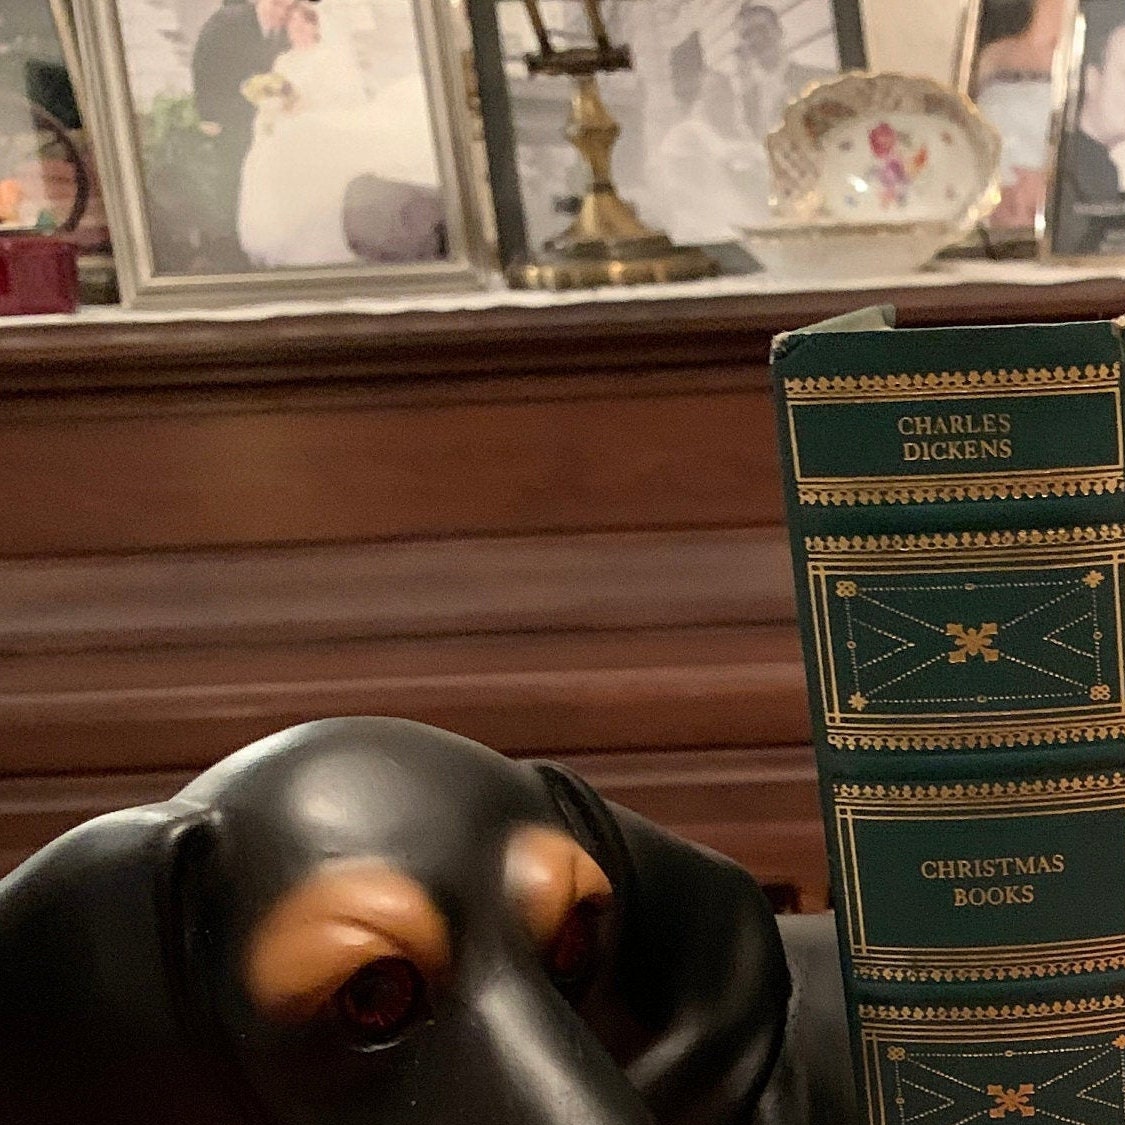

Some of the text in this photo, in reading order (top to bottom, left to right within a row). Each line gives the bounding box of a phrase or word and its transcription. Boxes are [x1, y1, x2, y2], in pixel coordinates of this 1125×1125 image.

[898, 413, 1011, 436] CHARLES
[903, 438, 1012, 461] DICKENS
[921, 854, 1065, 879] CHRISTMAS
[953, 884, 1034, 906] BOOKS
